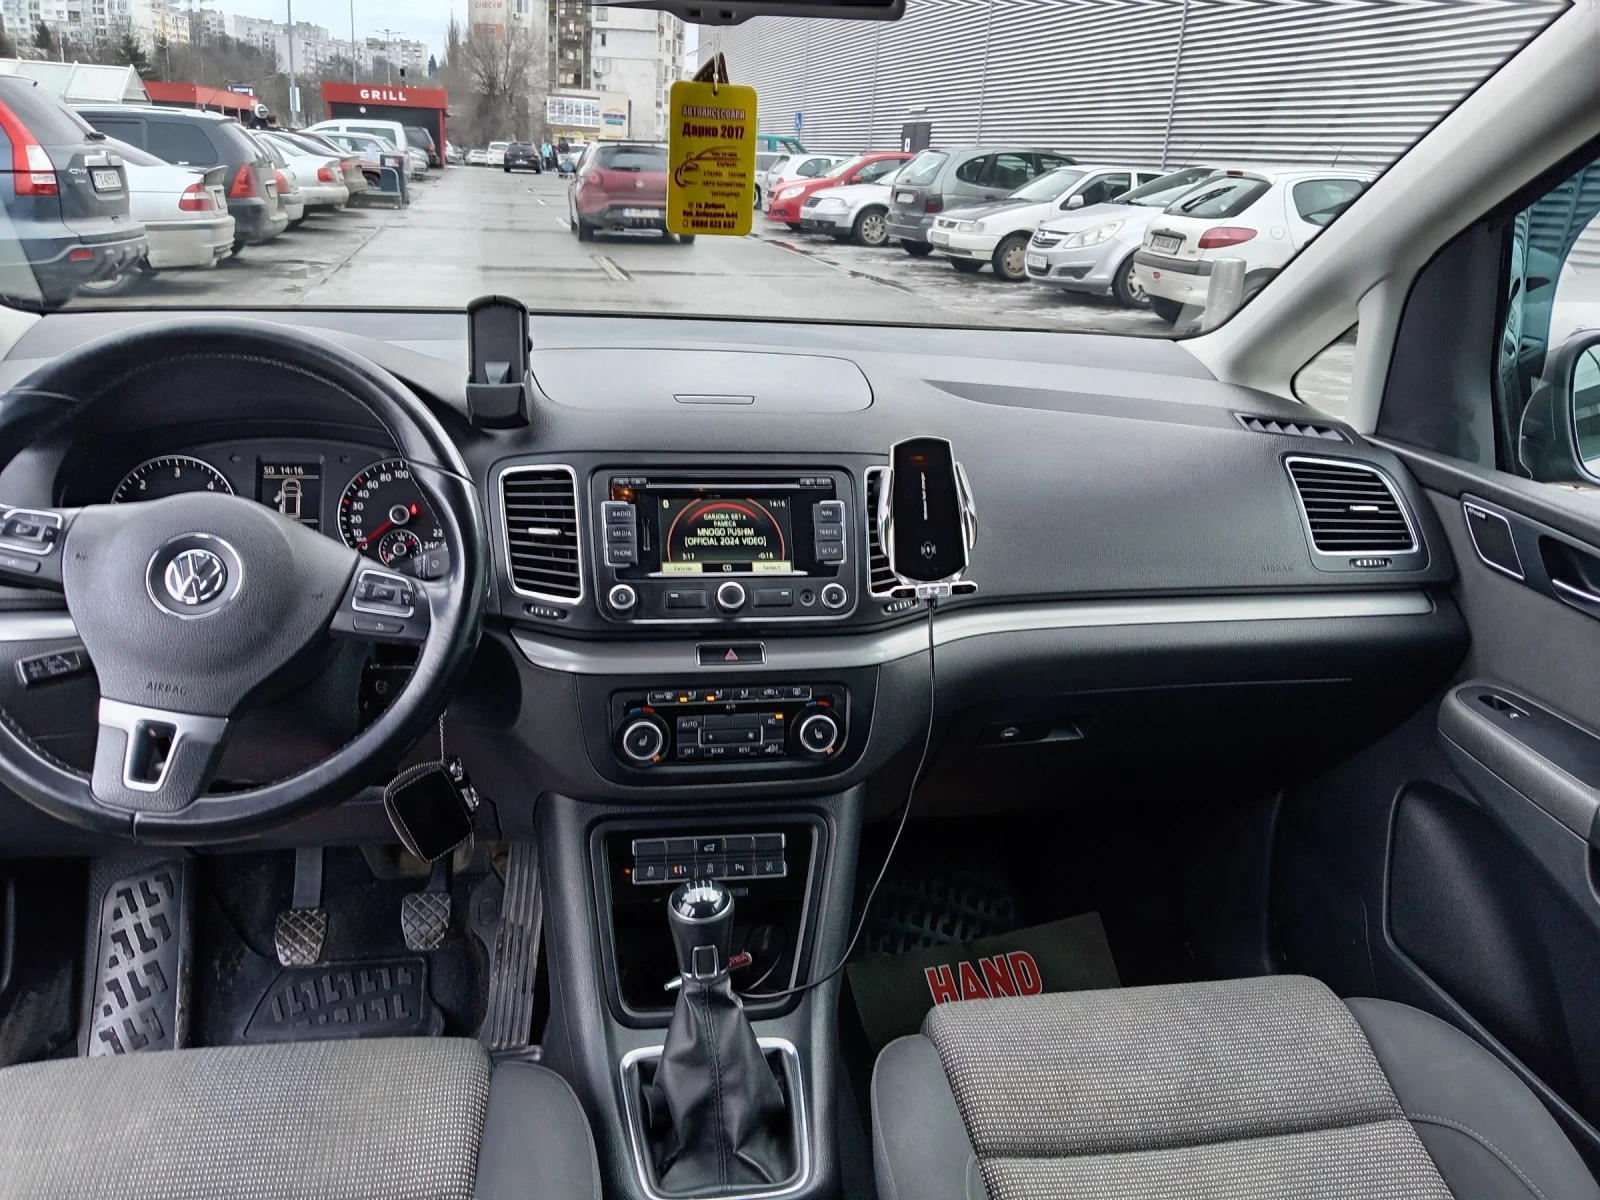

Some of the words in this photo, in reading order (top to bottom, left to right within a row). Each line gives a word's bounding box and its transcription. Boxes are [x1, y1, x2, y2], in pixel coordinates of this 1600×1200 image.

[360, 89, 407, 101] GRILL
[721, 124, 745, 139] 2017
[174, 466, 181, 478] 3
[280, 465, 304, 476] 14:16
[394, 469, 409, 479] 100
[380, 473, 392, 482] 80
[139, 479, 146, 490] 2
[206, 480, 215, 491] 4
[366, 480, 379, 489] 60
[357, 489, 370, 499] 40
[352, 501, 364, 511] 30
[612, 510, 632, 518] RADIO
[821, 509, 833, 517] NAV
[350, 514, 362, 524] 20
[353, 528, 363, 537] 10
[612, 530, 632, 538] MEDIA
[696, 528, 726, 537] MNOGO
[727, 528, 755, 537] PUSHIM
[720, 537, 740, 546] 2024
[821, 547, 838, 555] SETUP
[684, 747, 694, 755] OFF
[924, 950, 1043, 1007] HAND
